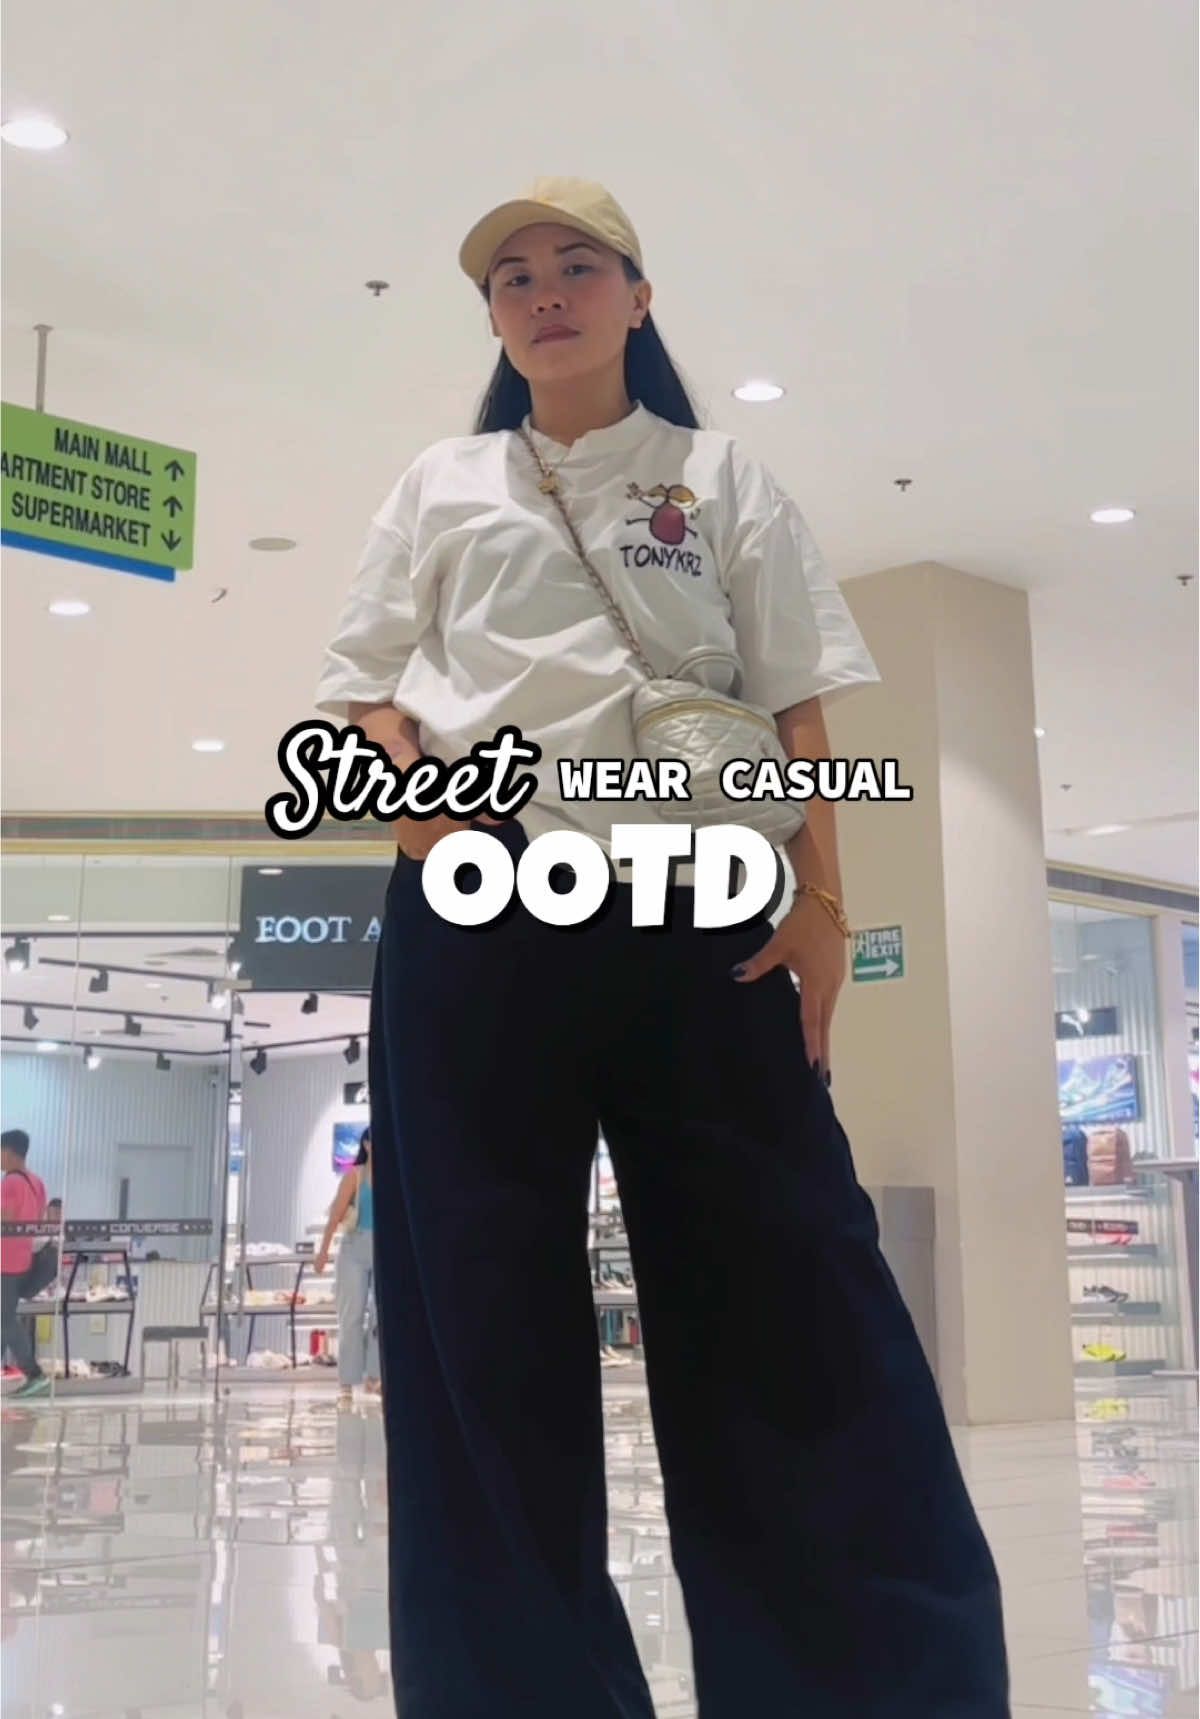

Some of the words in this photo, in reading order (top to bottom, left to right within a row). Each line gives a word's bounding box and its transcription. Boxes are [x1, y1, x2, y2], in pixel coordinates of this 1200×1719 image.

[54, 428, 99, 461] MAIN
[105, 441, 152, 476] MALL
[91, 475, 151, 511] STORE
[11, 491, 151, 547] SUPERMARKET
